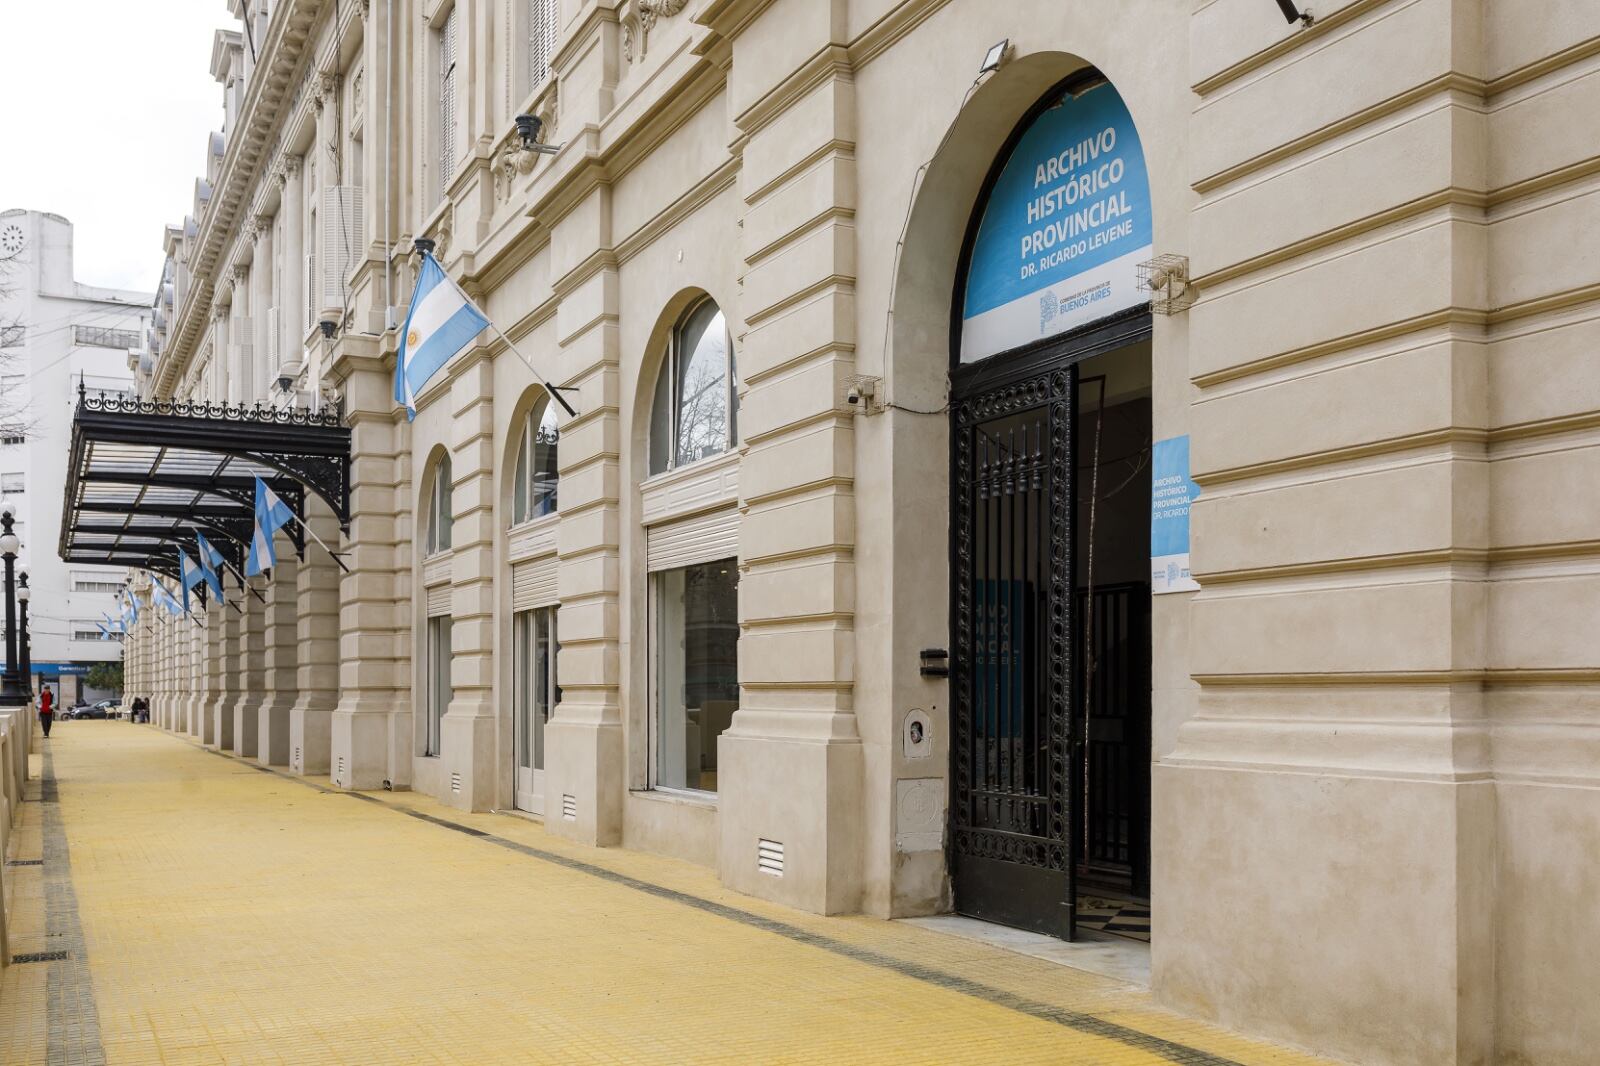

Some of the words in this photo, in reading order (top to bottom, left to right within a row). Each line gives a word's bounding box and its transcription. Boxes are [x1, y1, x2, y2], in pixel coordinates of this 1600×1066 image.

[1034, 127, 1116, 189] ARCHIVO
[1027, 157, 1124, 224] HISTÓRICO
[1021, 190, 1132, 259] PROVINCIAL
[1021, 262, 1038, 279] DR.
[1040, 240, 1086, 271] RICARDO
[1089, 219, 1133, 250] LEVENE
[1060, 294, 1088, 314] BUENOS
[1090, 286, 1112, 303] AIRES
[1153, 475, 1182, 487] ARCHIVO
[1153, 495, 1191, 509] PROVINCIAL
